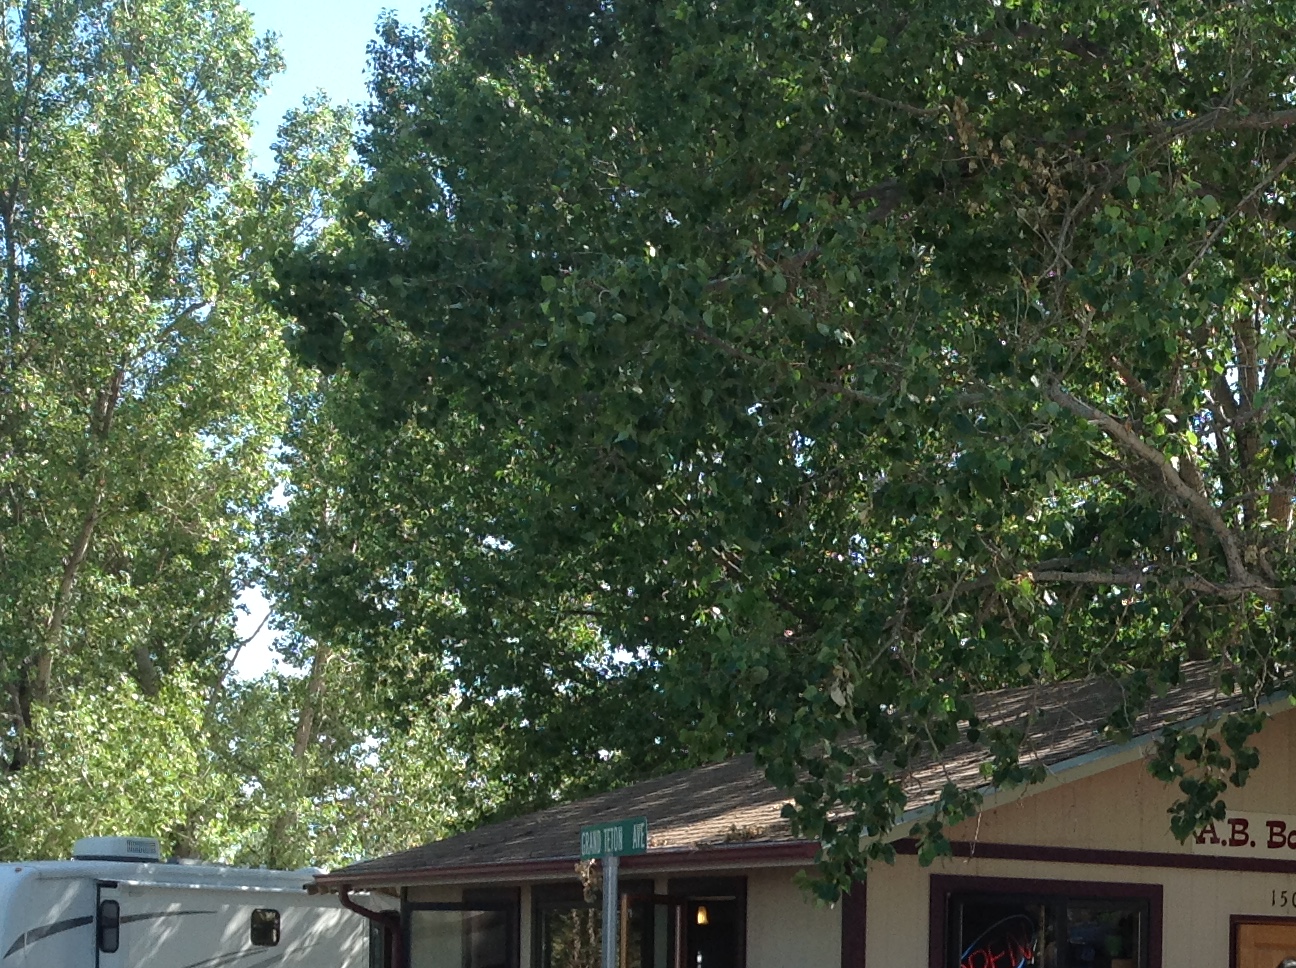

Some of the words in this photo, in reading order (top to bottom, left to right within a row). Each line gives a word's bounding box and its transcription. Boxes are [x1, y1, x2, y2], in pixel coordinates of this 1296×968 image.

[581, 830, 601, 855] GRAND
[604, 827, 623, 851] TETON
[632, 823, 645, 849] AVE
